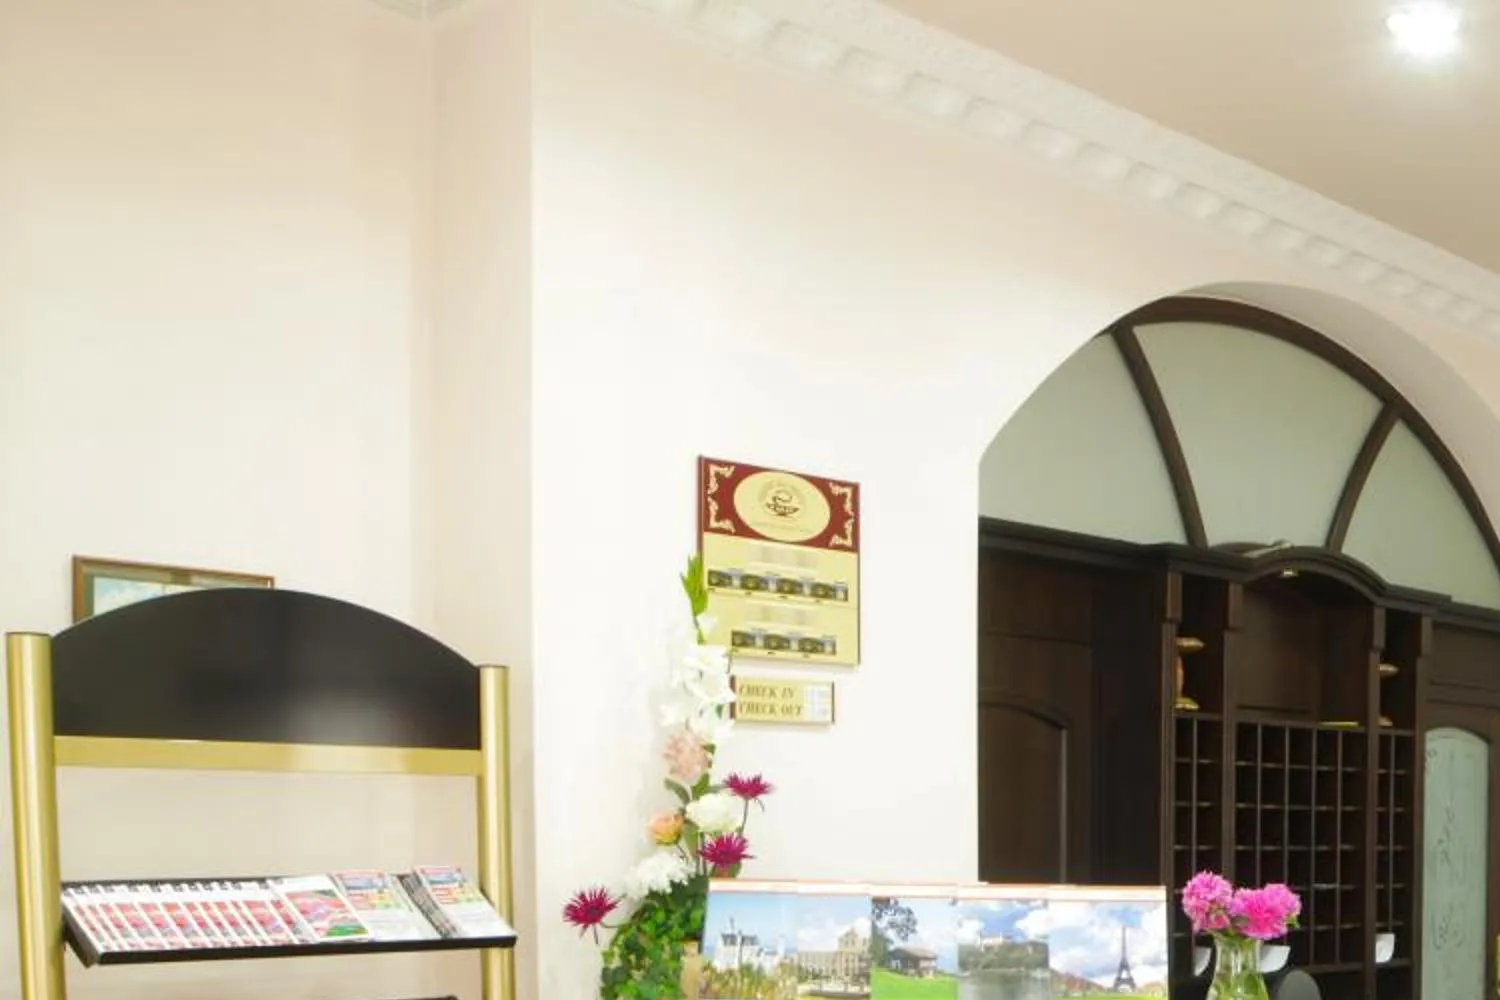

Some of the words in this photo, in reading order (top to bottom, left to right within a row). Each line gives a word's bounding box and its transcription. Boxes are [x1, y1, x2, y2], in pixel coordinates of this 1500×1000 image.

[739, 684, 777, 699] CHECK
[781, 686, 796, 698] IN
[739, 702, 777, 716] CHECK
[781, 704, 804, 716] OUT
